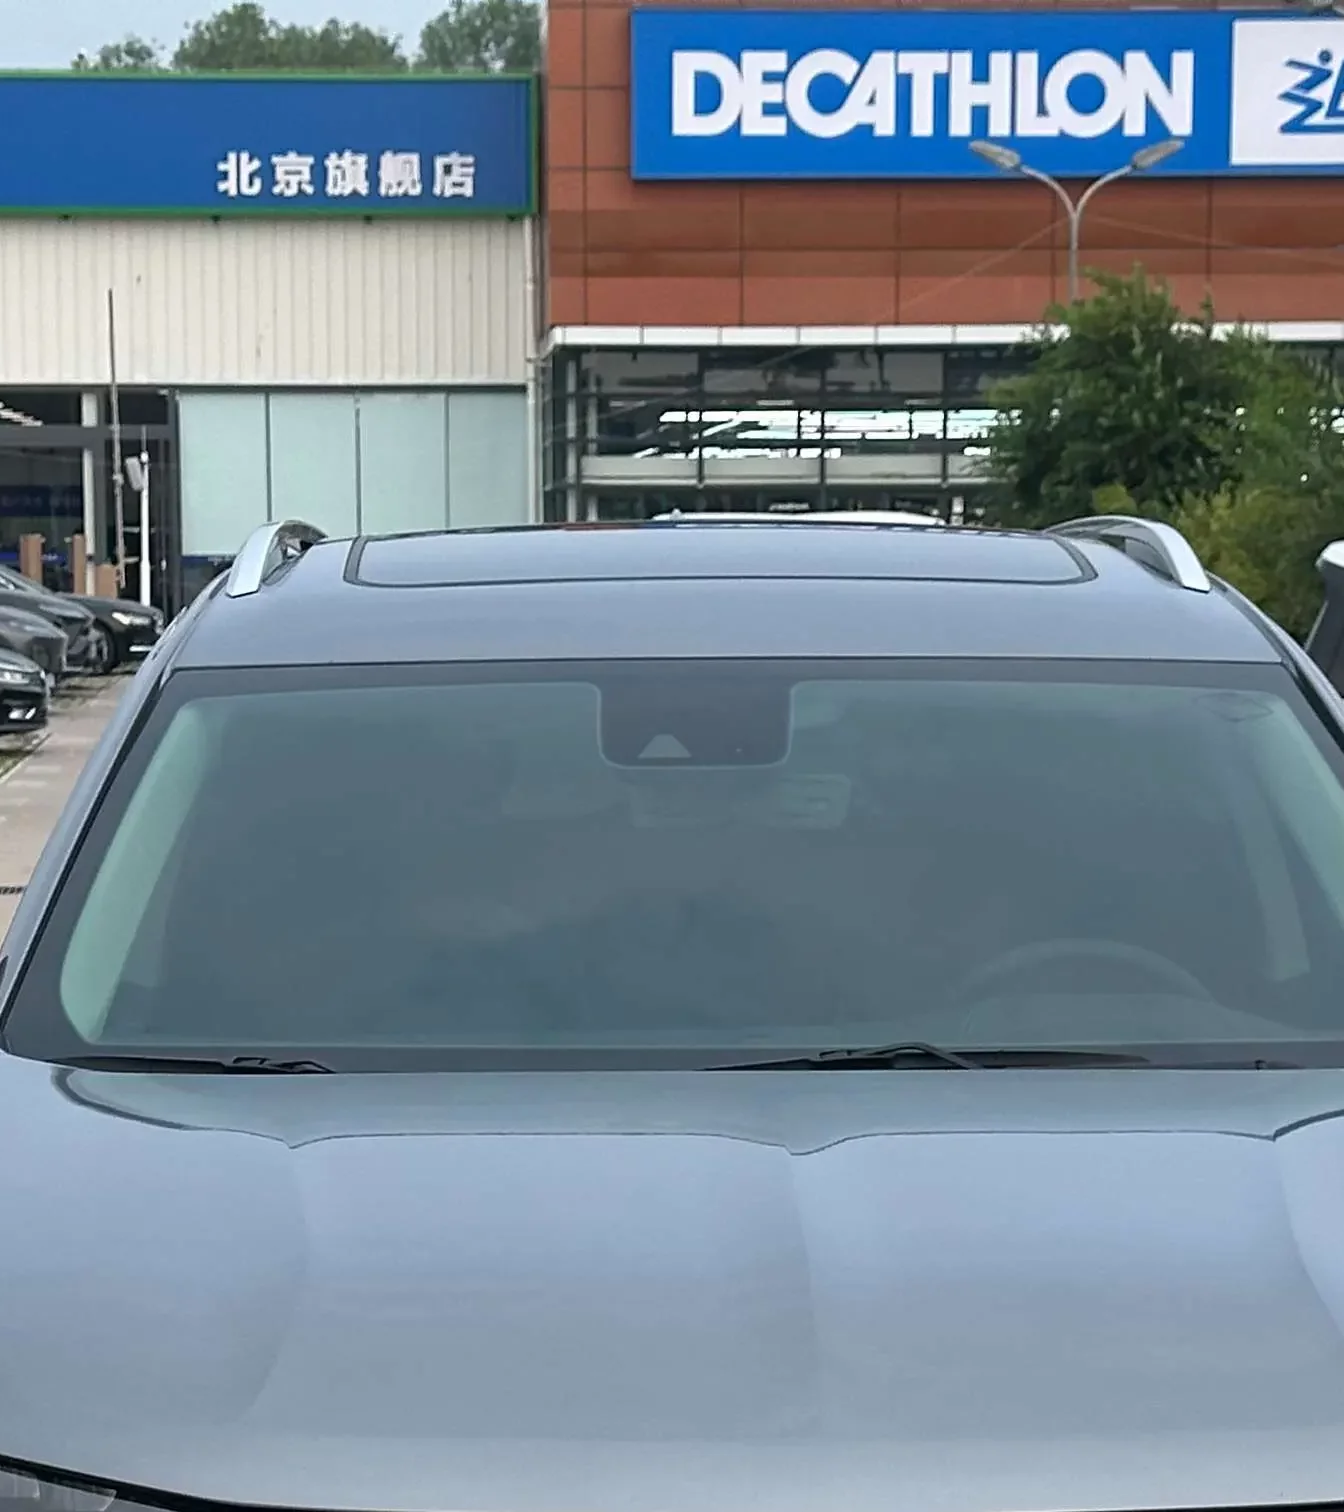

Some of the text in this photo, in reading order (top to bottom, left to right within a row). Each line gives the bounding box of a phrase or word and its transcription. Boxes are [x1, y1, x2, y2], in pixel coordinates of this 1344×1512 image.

[671, 49, 1194, 138] DECATHLON
[216, 150, 477, 199] 北京旗舰店
